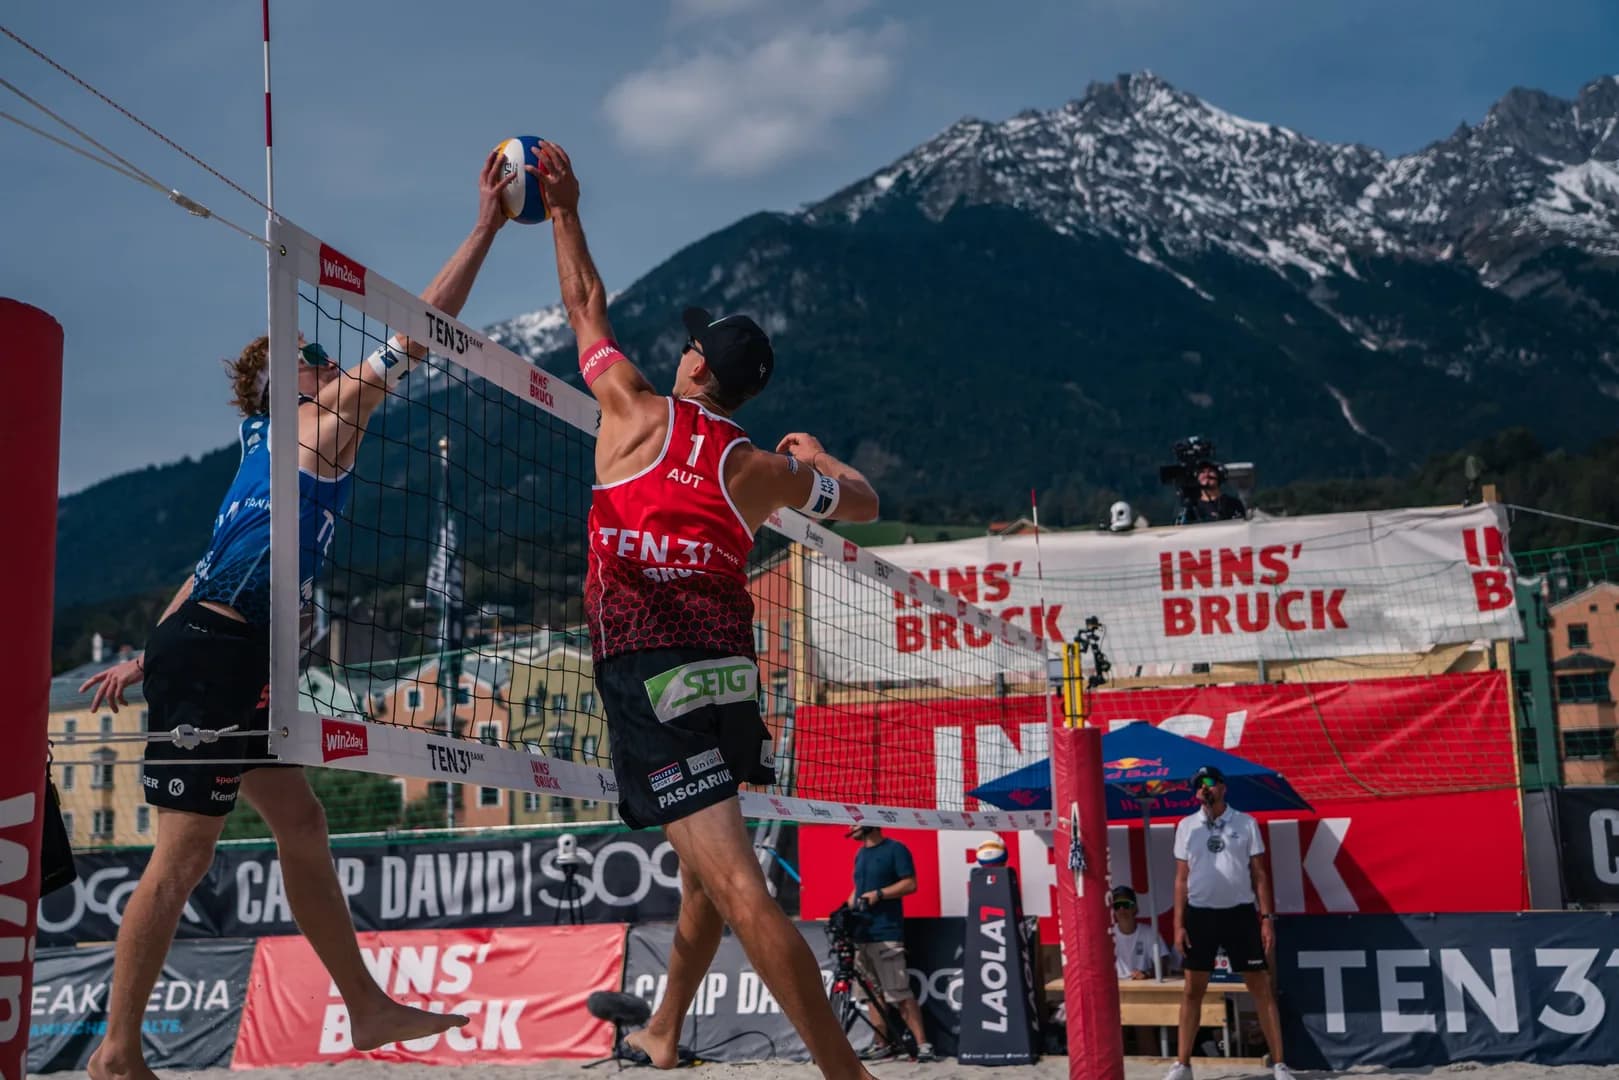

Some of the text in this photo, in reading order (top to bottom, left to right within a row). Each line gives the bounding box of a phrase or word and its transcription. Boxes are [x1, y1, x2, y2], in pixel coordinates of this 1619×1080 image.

[324, 258, 361, 289] win2day
[426, 312, 469, 354] TEN31
[529, 384, 554, 408] BRUCK
[687, 435, 705, 468] 1
[667, 468, 704, 488] AUT
[1159, 543, 1302, 591] INNS'
[1163, 588, 1349, 637] BRUCK
[326, 729, 364, 752] win2day
[427, 744, 471, 774] TEN31
[236, 858, 365, 925] CAP
[380, 850, 516, 920] DAVID
[328, 943, 493, 997] NNS'
[1298, 948, 1619, 1034] TEN3
[319, 1000, 527, 1054] BUCK
